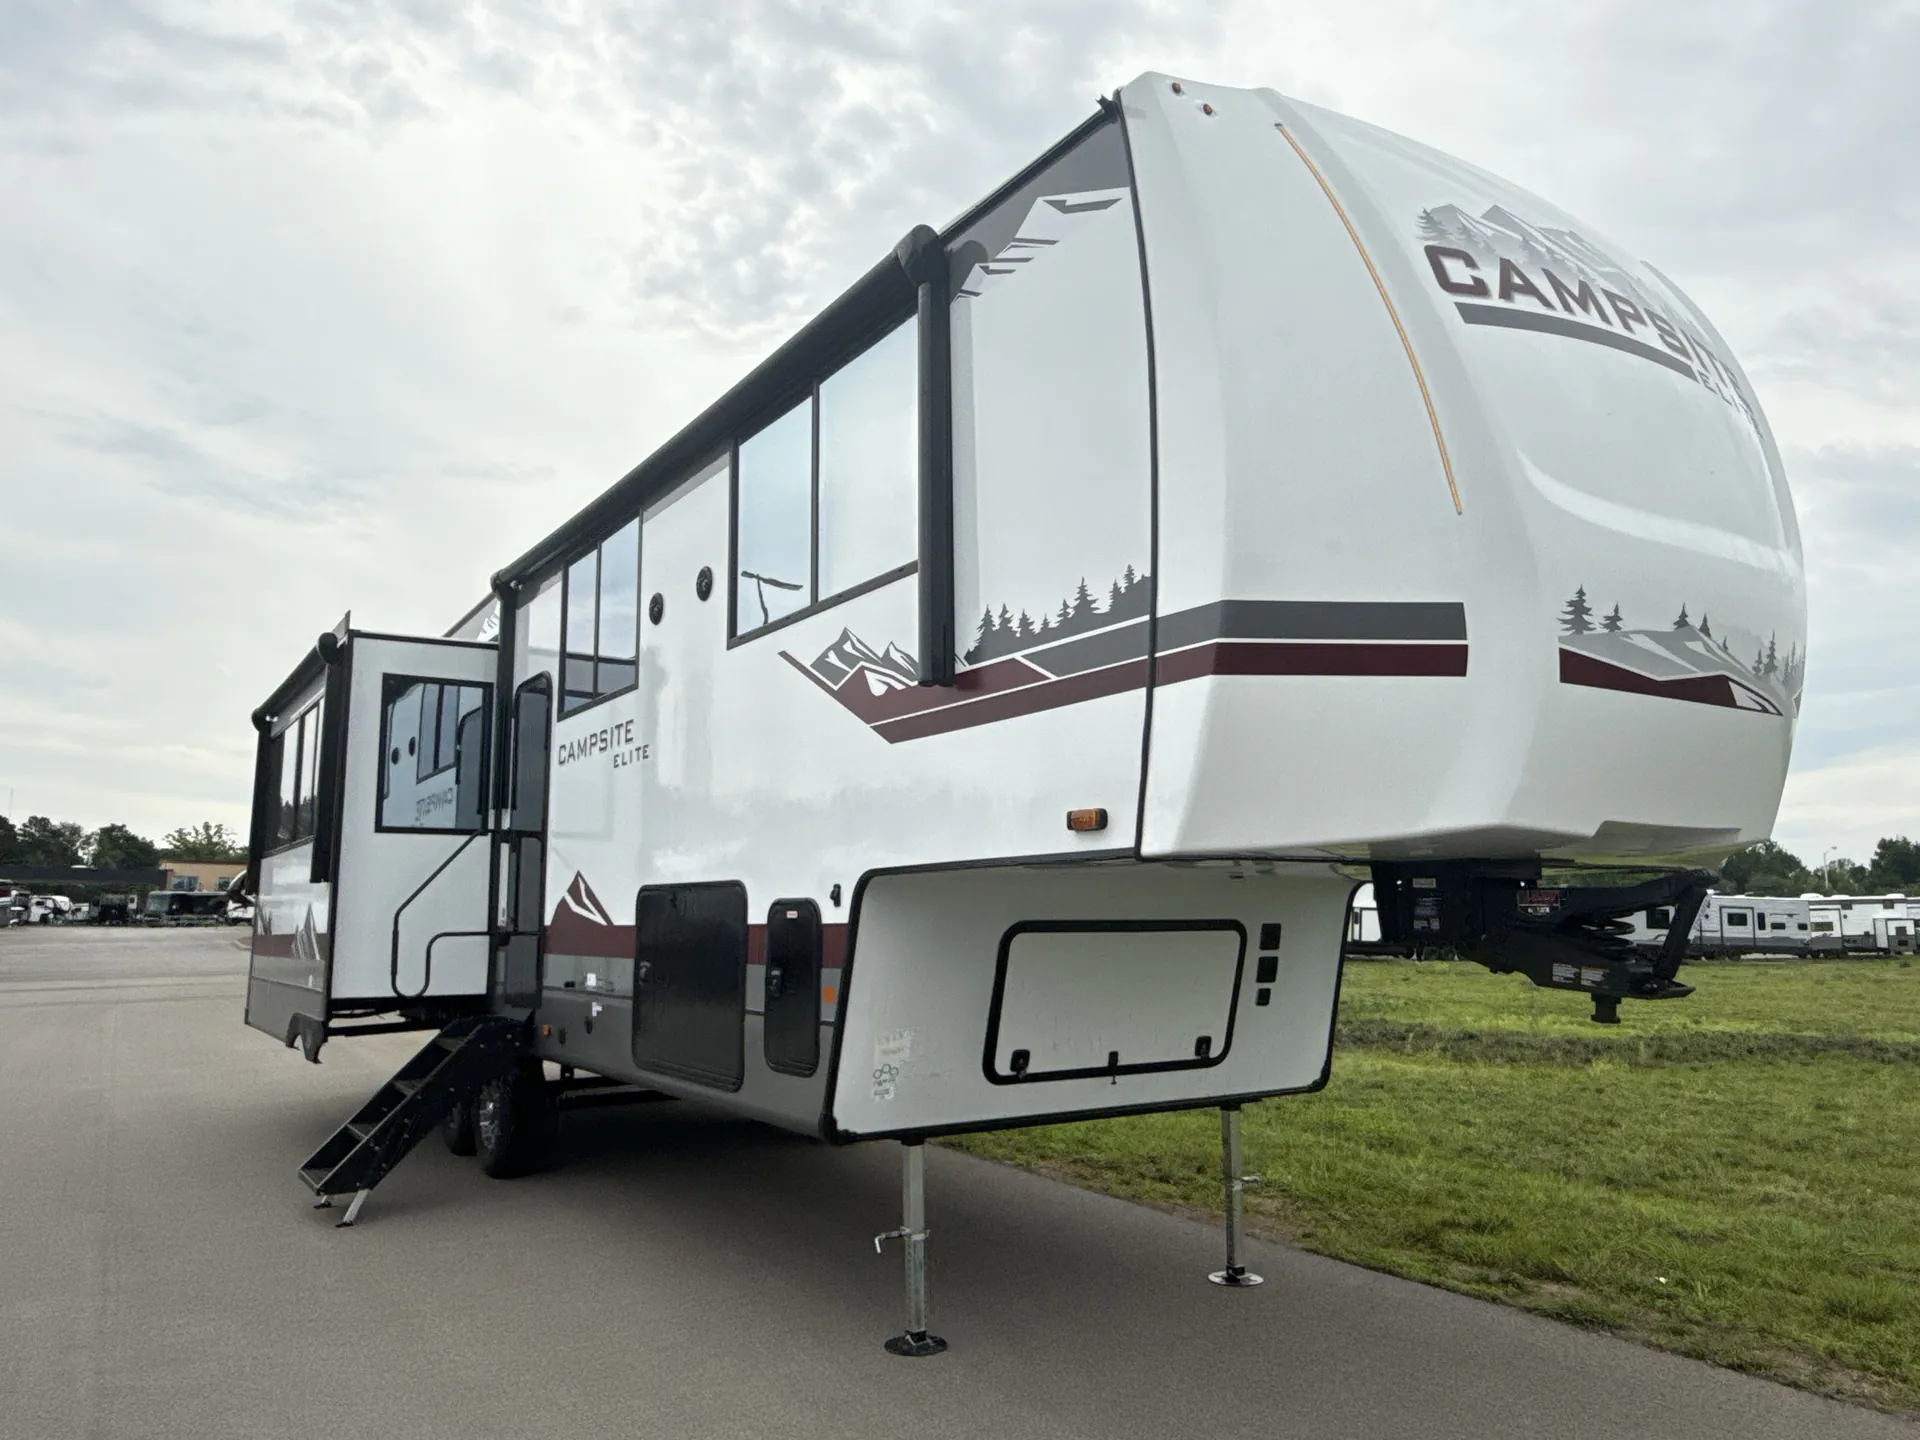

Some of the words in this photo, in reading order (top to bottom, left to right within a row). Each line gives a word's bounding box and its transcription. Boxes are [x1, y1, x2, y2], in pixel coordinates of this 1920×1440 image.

[1423, 244, 1755, 416] CAMPSITE
[558, 719, 634, 765] CAMPSITE
[613, 744, 649, 769] ELITE
